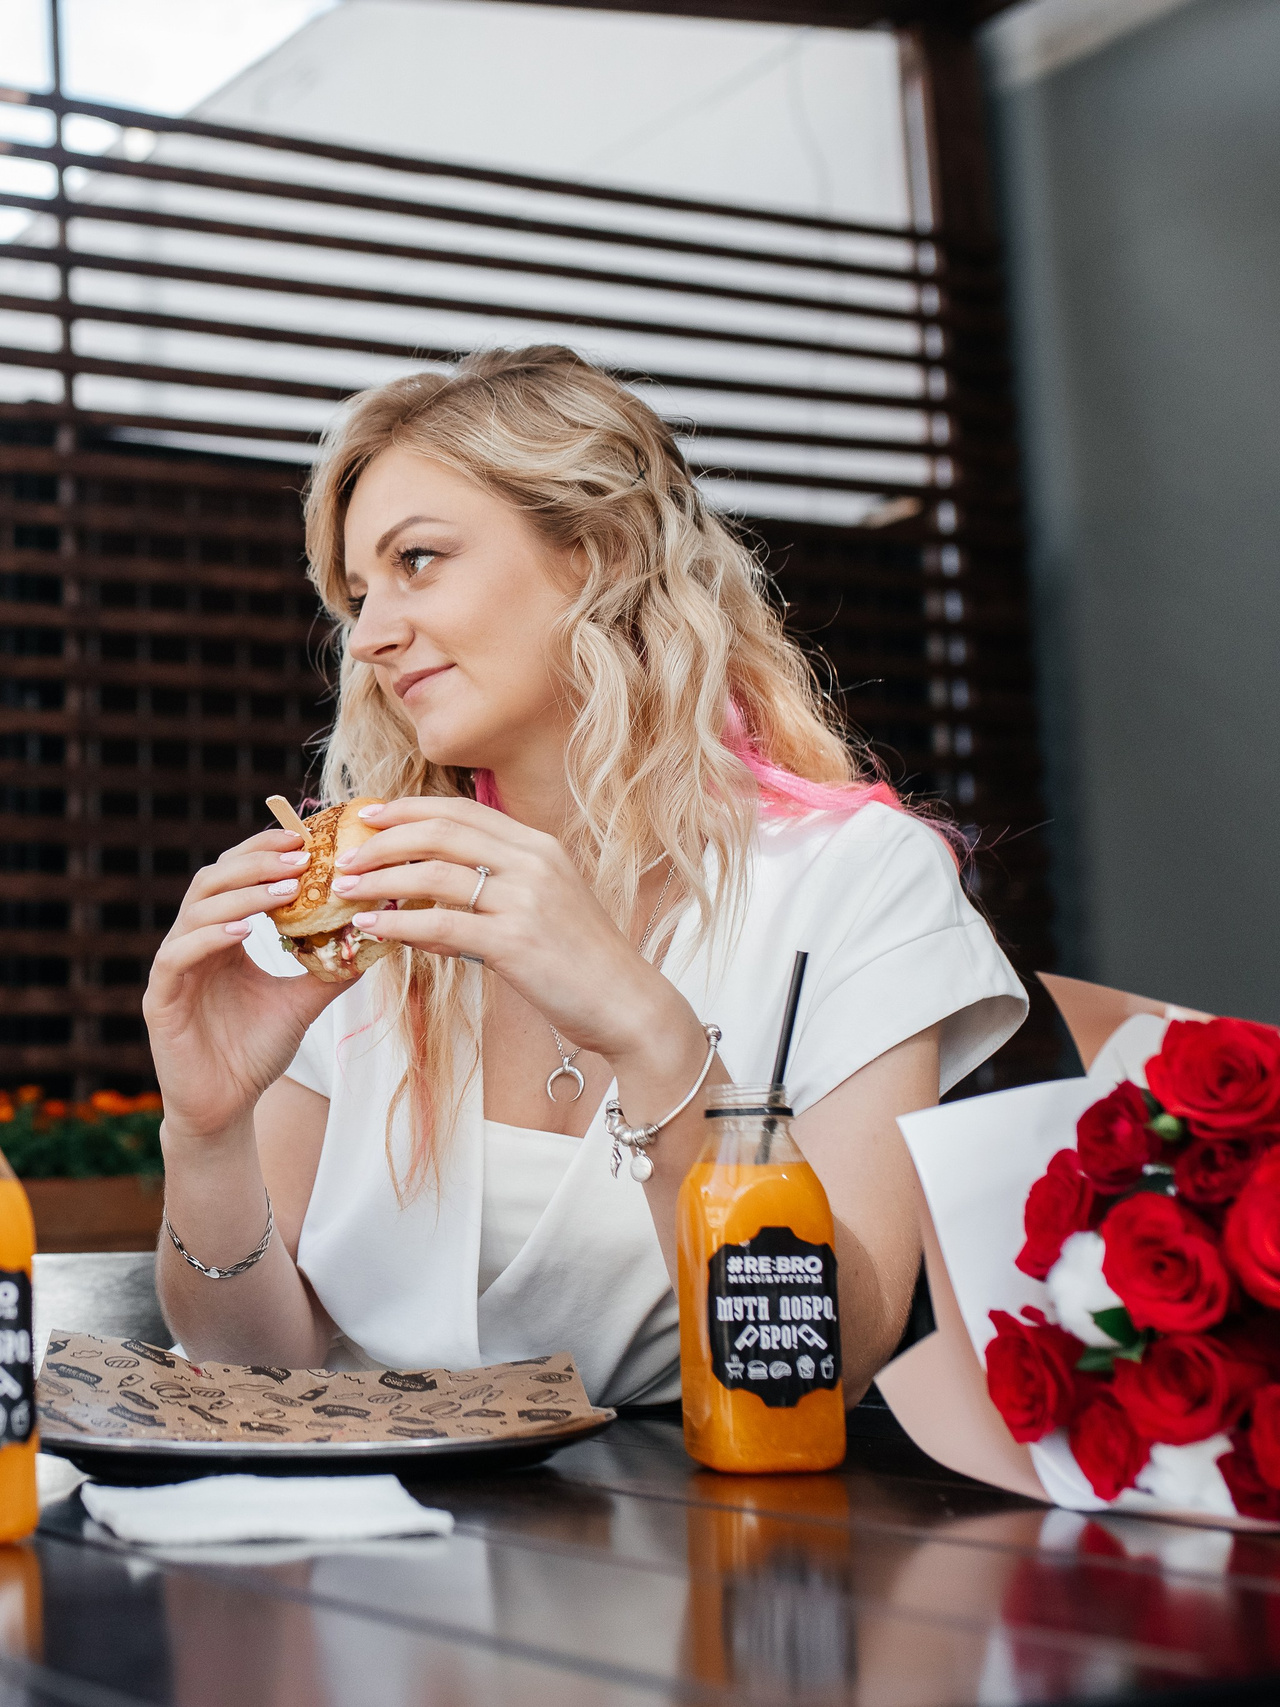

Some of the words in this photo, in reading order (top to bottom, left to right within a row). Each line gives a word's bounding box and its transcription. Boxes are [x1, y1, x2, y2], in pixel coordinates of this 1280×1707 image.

[726, 1255, 823, 1274] #RE:BRO
[716, 1296, 770, 1321] МУТИ
[758, 1324, 799, 1350] БРО!
